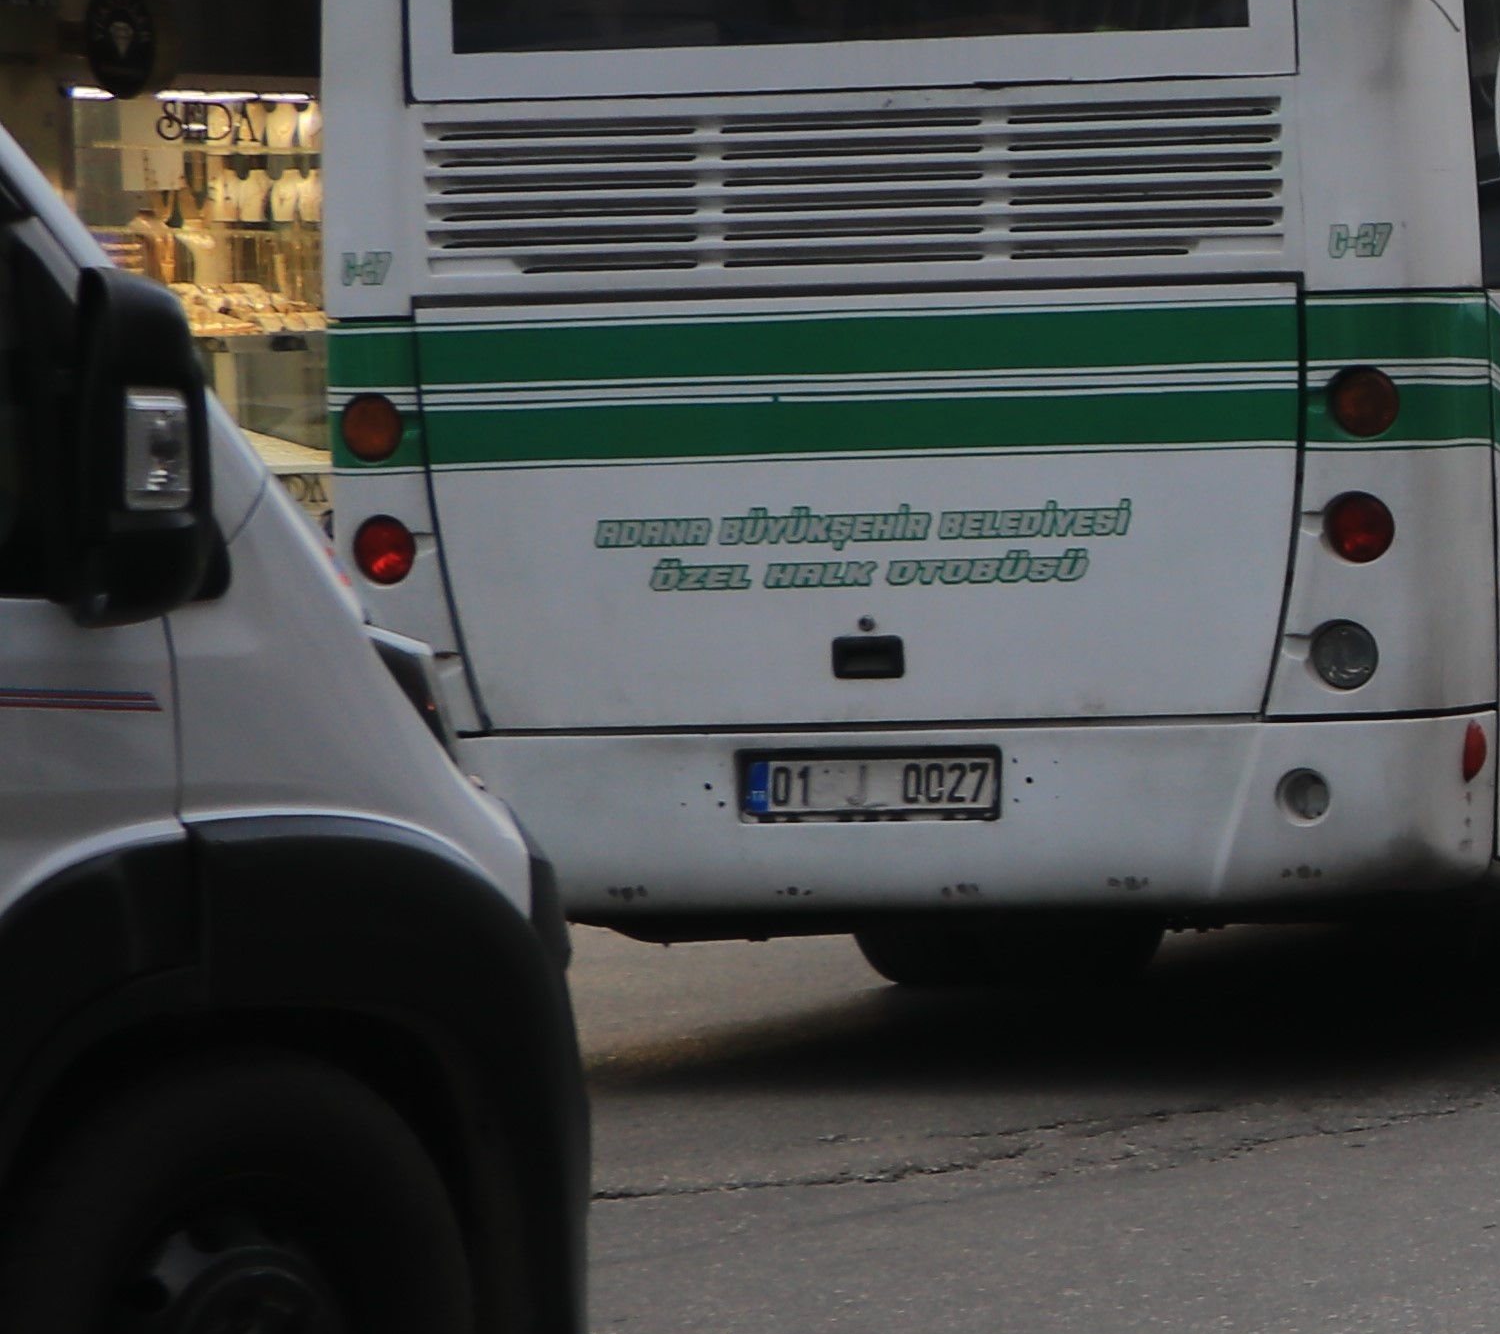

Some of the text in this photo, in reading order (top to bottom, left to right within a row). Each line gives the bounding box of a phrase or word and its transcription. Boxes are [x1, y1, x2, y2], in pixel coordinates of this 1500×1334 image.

[1328, 221, 1394, 260] C-27
[595, 498, 1132, 550] ADANA BÜYÜKŞEHİR BELEDİYESİ
[649, 548, 1091, 592] ÖZEL HALK OTOBÜSÜ
[772, 765, 810, 807] 01
[903, 762, 992, 803] 0027
